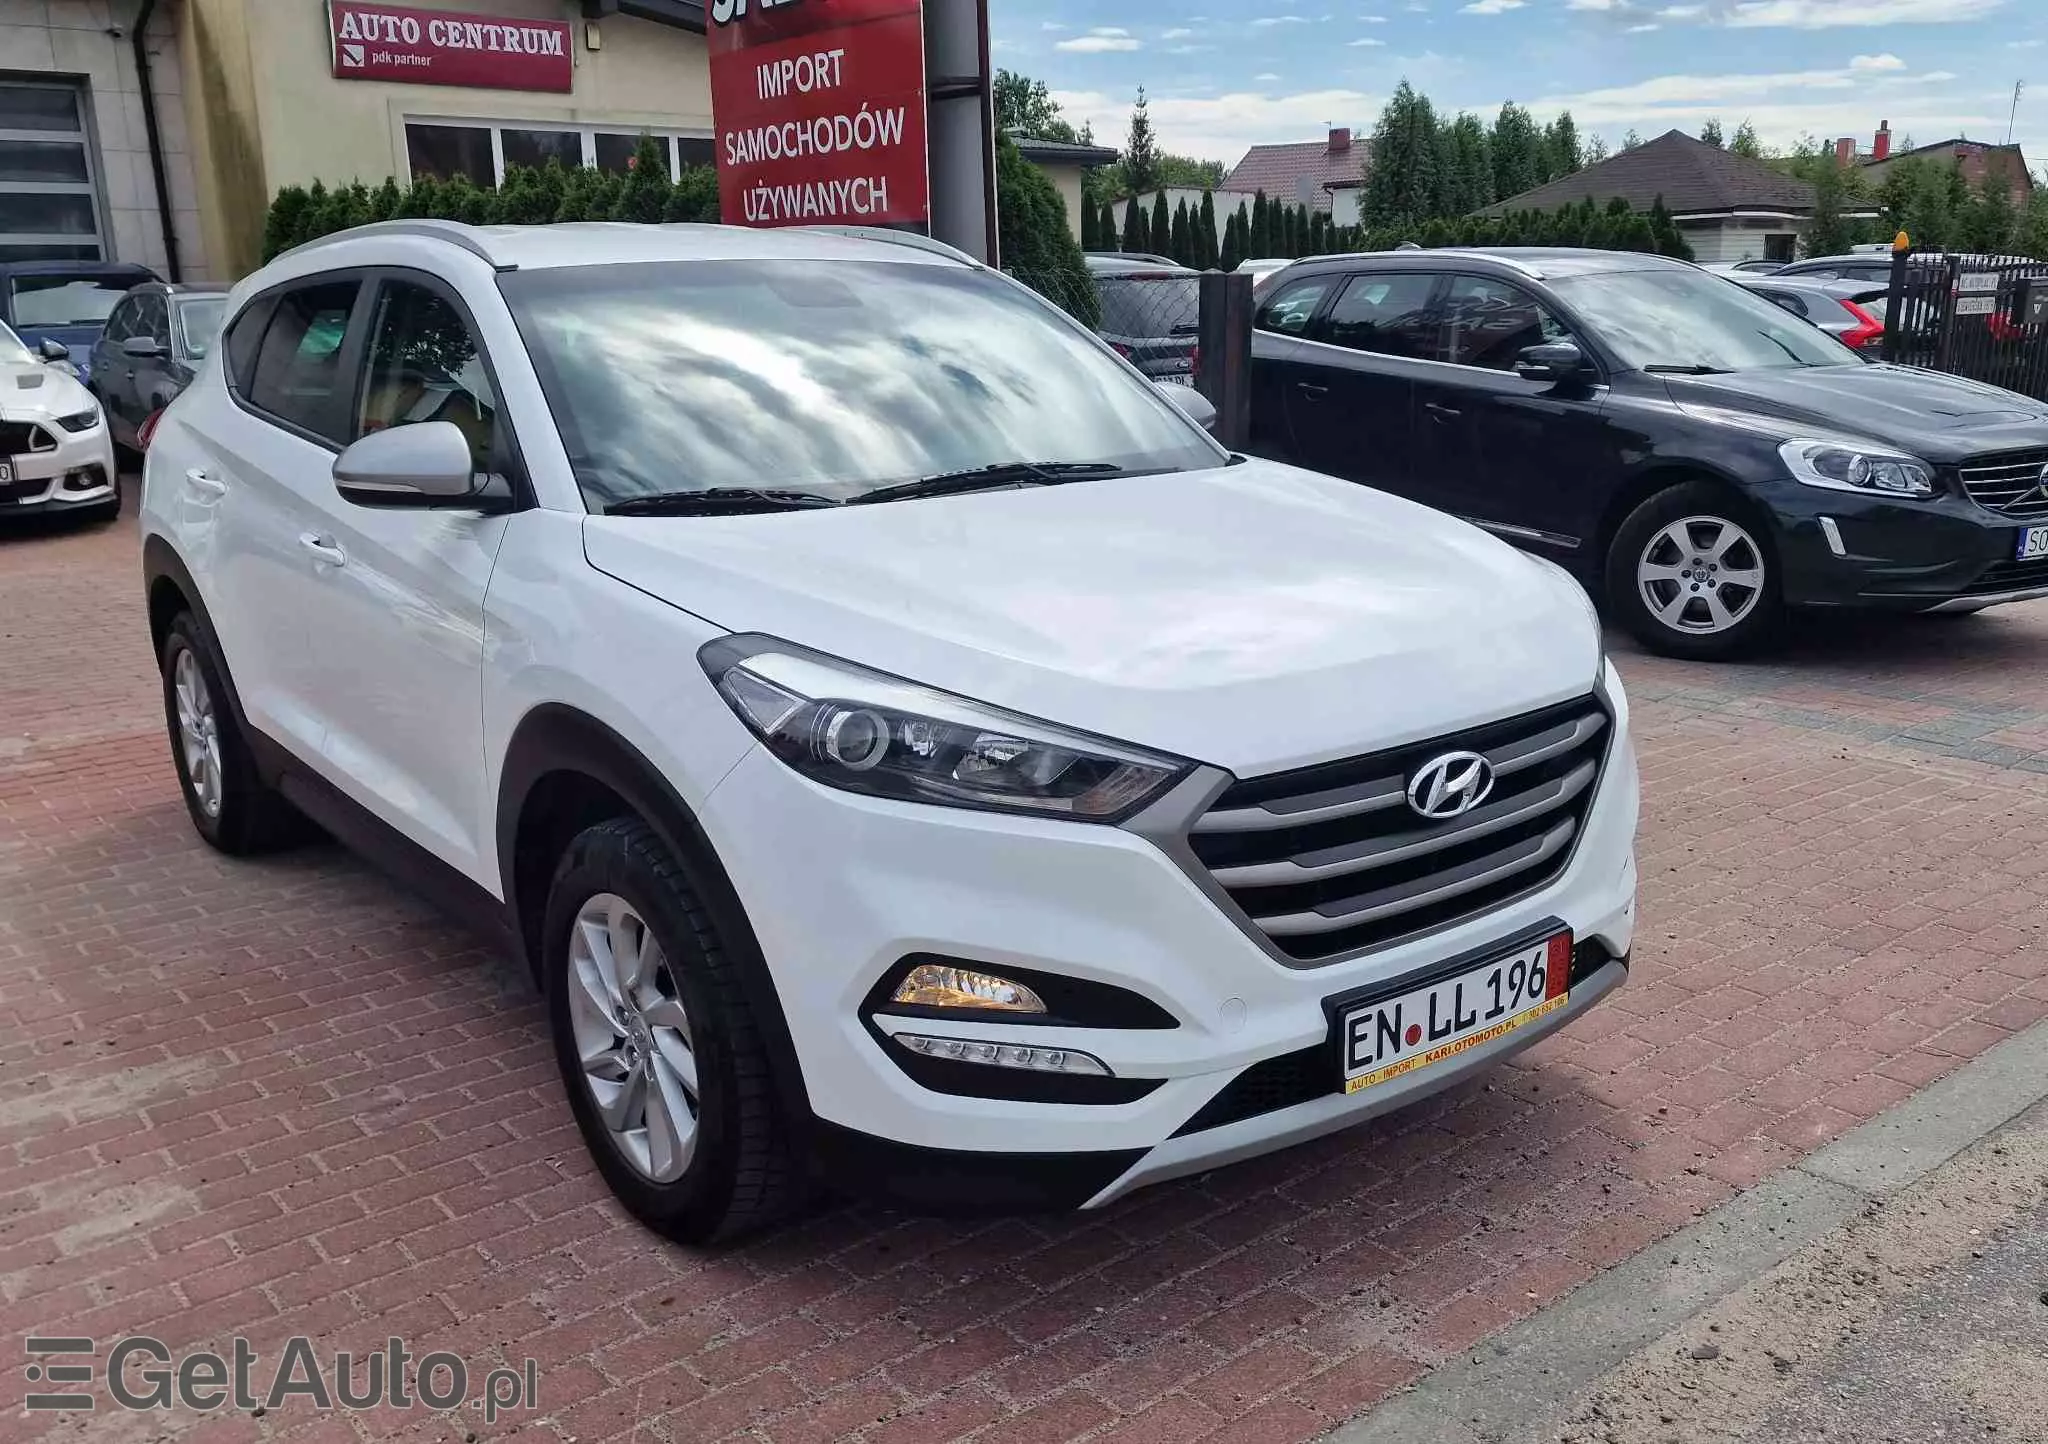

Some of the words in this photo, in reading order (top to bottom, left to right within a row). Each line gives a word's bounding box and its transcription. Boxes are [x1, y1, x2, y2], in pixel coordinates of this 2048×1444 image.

[339, 12, 421, 45] AUTO
[428, 20, 564, 56] CENTRUM
[372, 50, 392, 65] pdk
[394, 53, 431, 67] partner
[757, 48, 845, 100] IMPORT
[725, 102, 905, 165] SAMOCHODÓW
[743, 176, 888, 222] UŻYWANYCH
[1347, 1003, 1402, 1071] EN
[1429, 983, 1477, 1042] LL
[1485, 951, 1546, 1021] 196
[1351, 1073, 1376, 1091] AUTO
[1384, 1059, 1417, 1079] IMPORT
